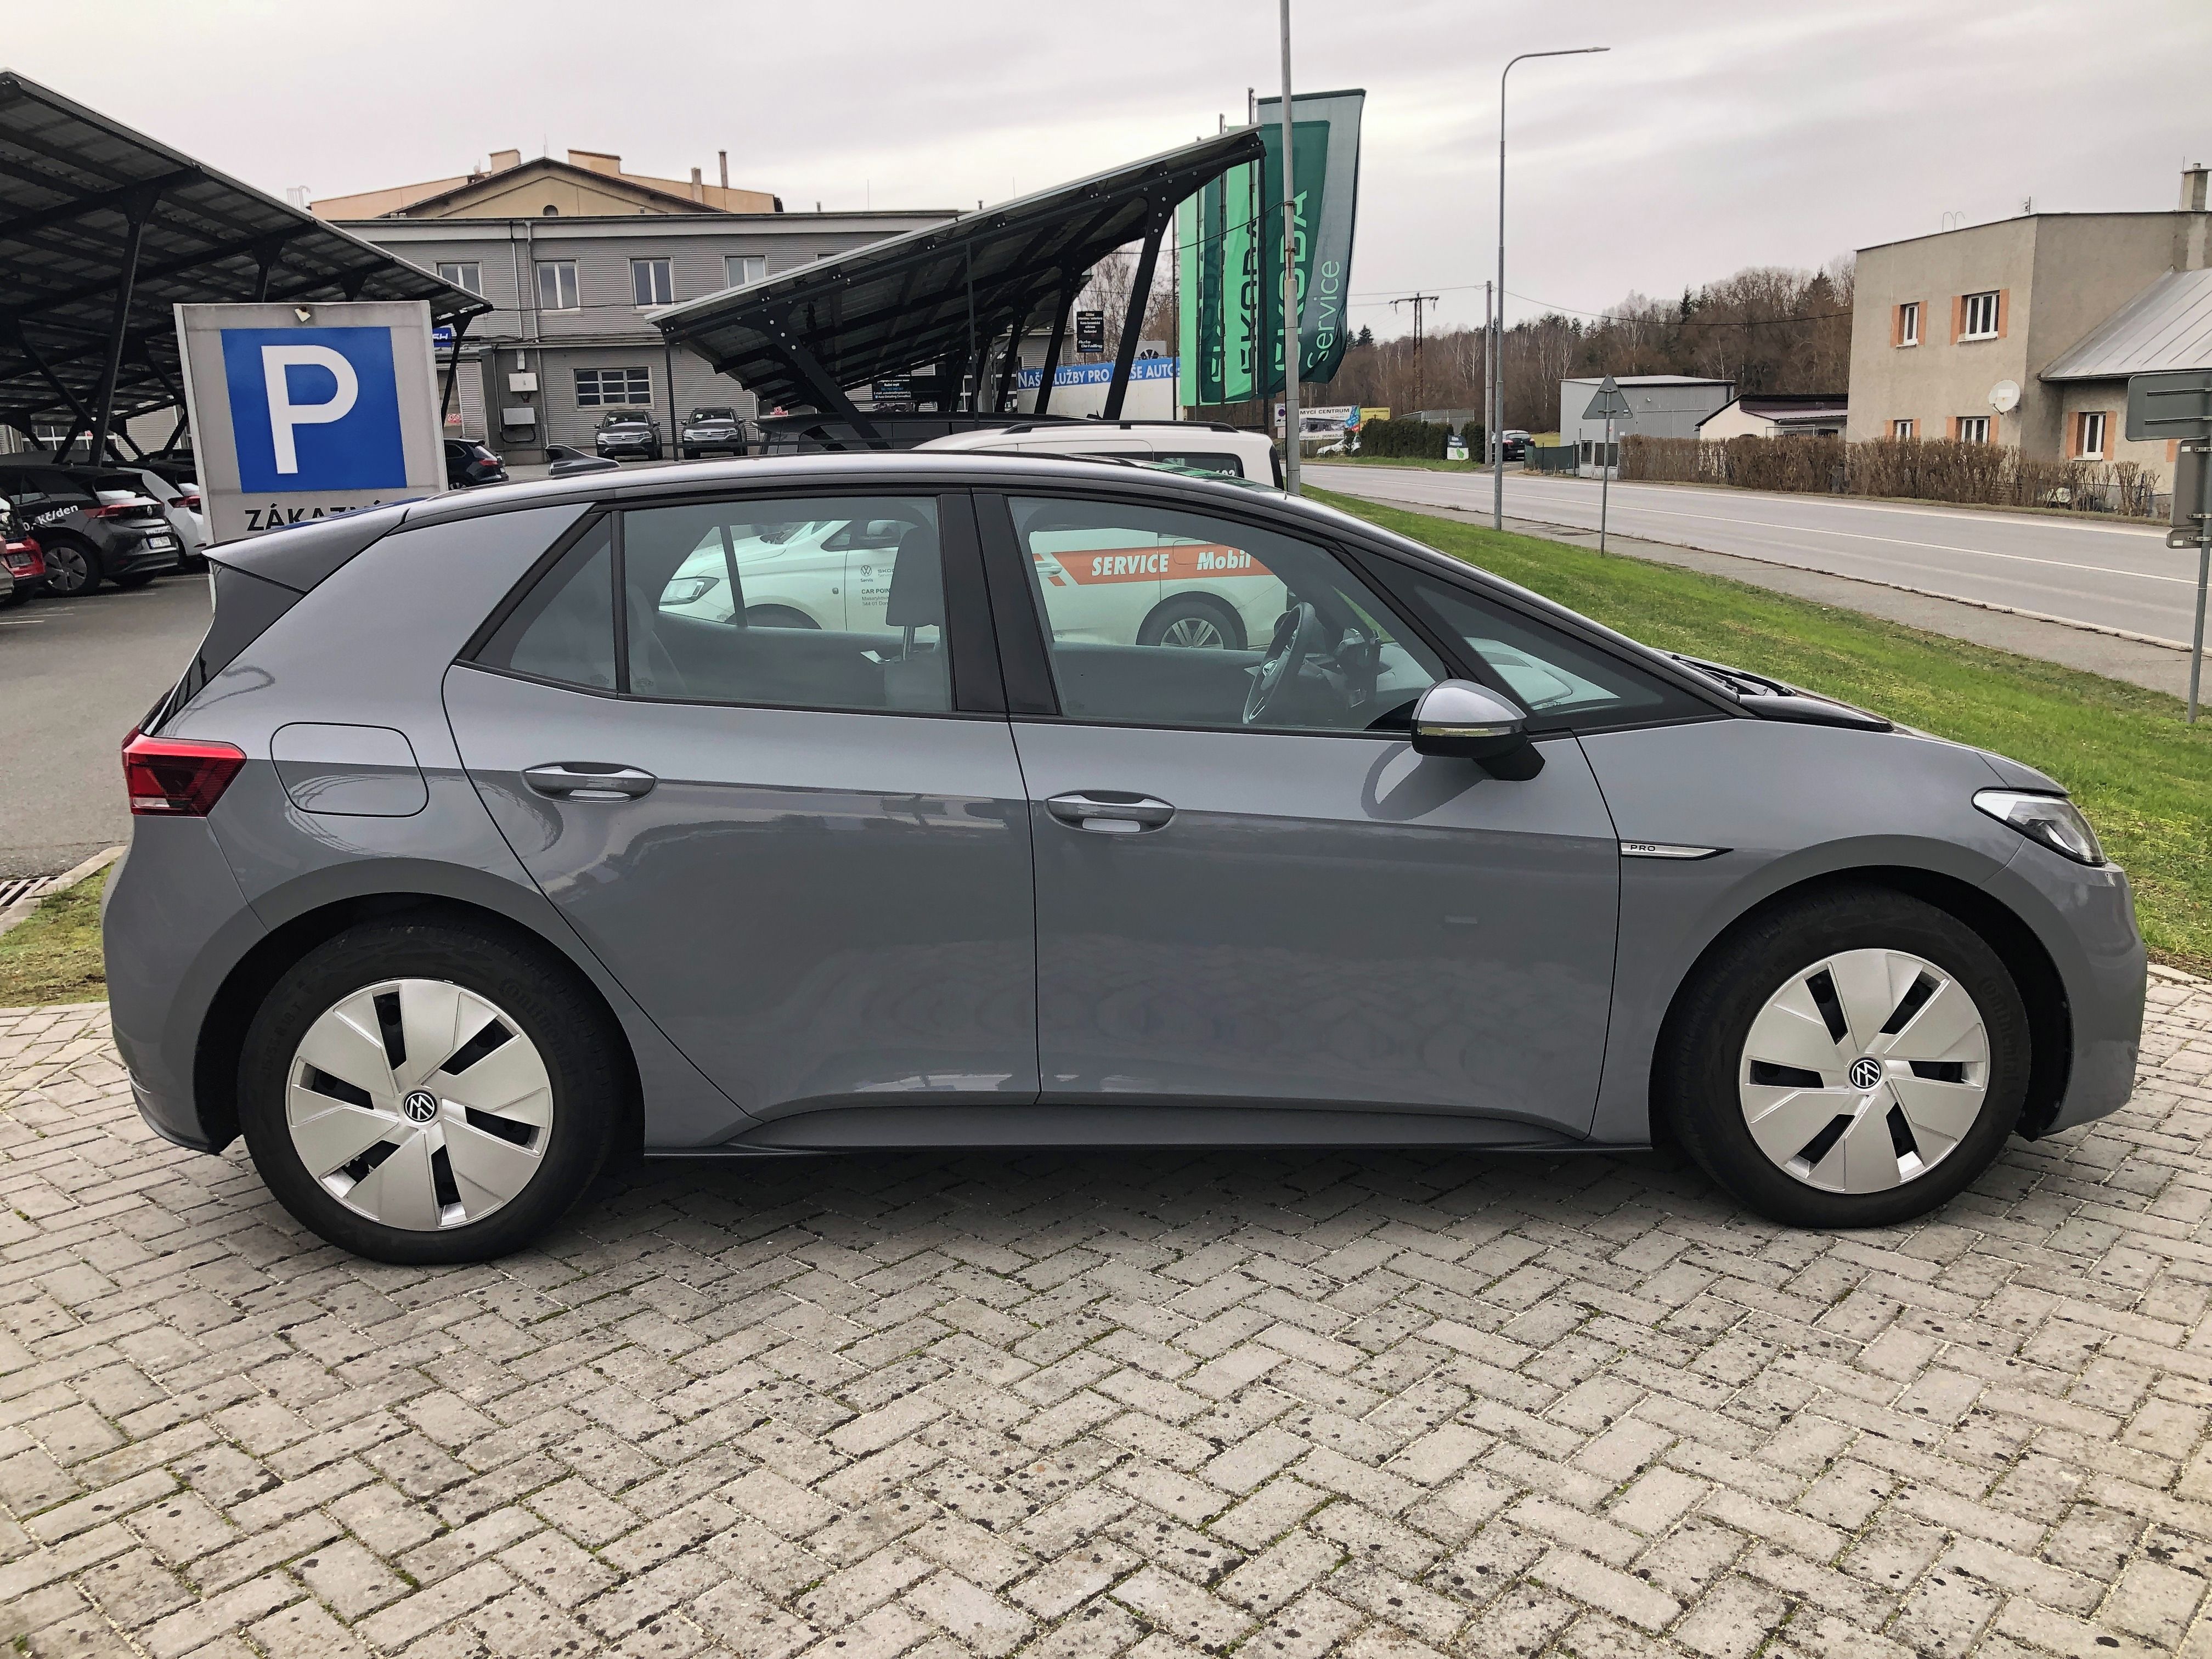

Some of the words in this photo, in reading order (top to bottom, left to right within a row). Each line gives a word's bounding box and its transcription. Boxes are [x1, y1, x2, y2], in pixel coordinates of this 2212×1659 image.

[1307, 260, 1340, 369] Service
[1053, 369, 1087, 385] LUŽBY
[1088, 369, 1110, 383] PRO
[261, 345, 359, 474] P
[1091, 553, 1170, 576] SERVICE
[1196, 550, 1251, 571] Mobil
